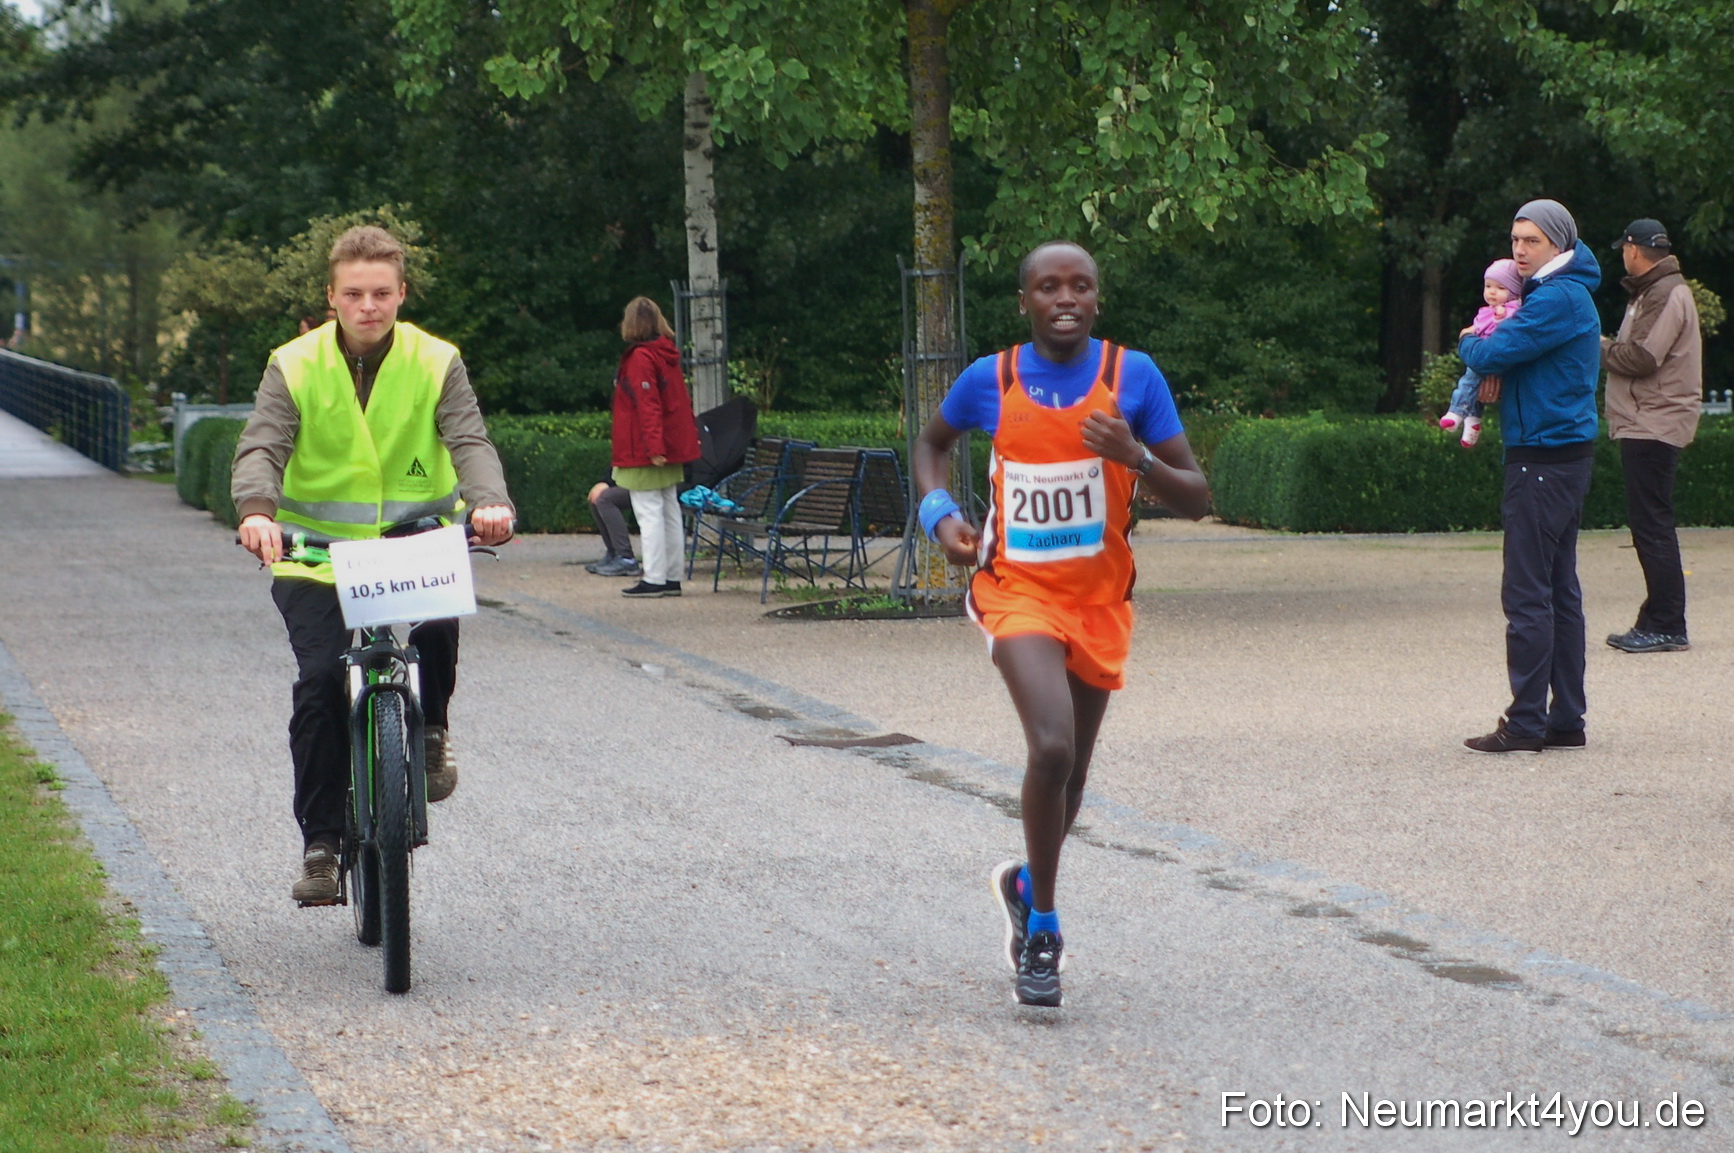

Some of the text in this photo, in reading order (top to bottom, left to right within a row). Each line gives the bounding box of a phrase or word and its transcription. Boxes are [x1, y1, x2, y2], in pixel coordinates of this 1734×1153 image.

[1005, 471, 1084, 484] PARTL Neumarkt
[1012, 484, 1093, 524] 2001
[1027, 531, 1081, 548] Zachary
[349, 582, 385, 599] 10,5
[390, 579, 416, 593] km
